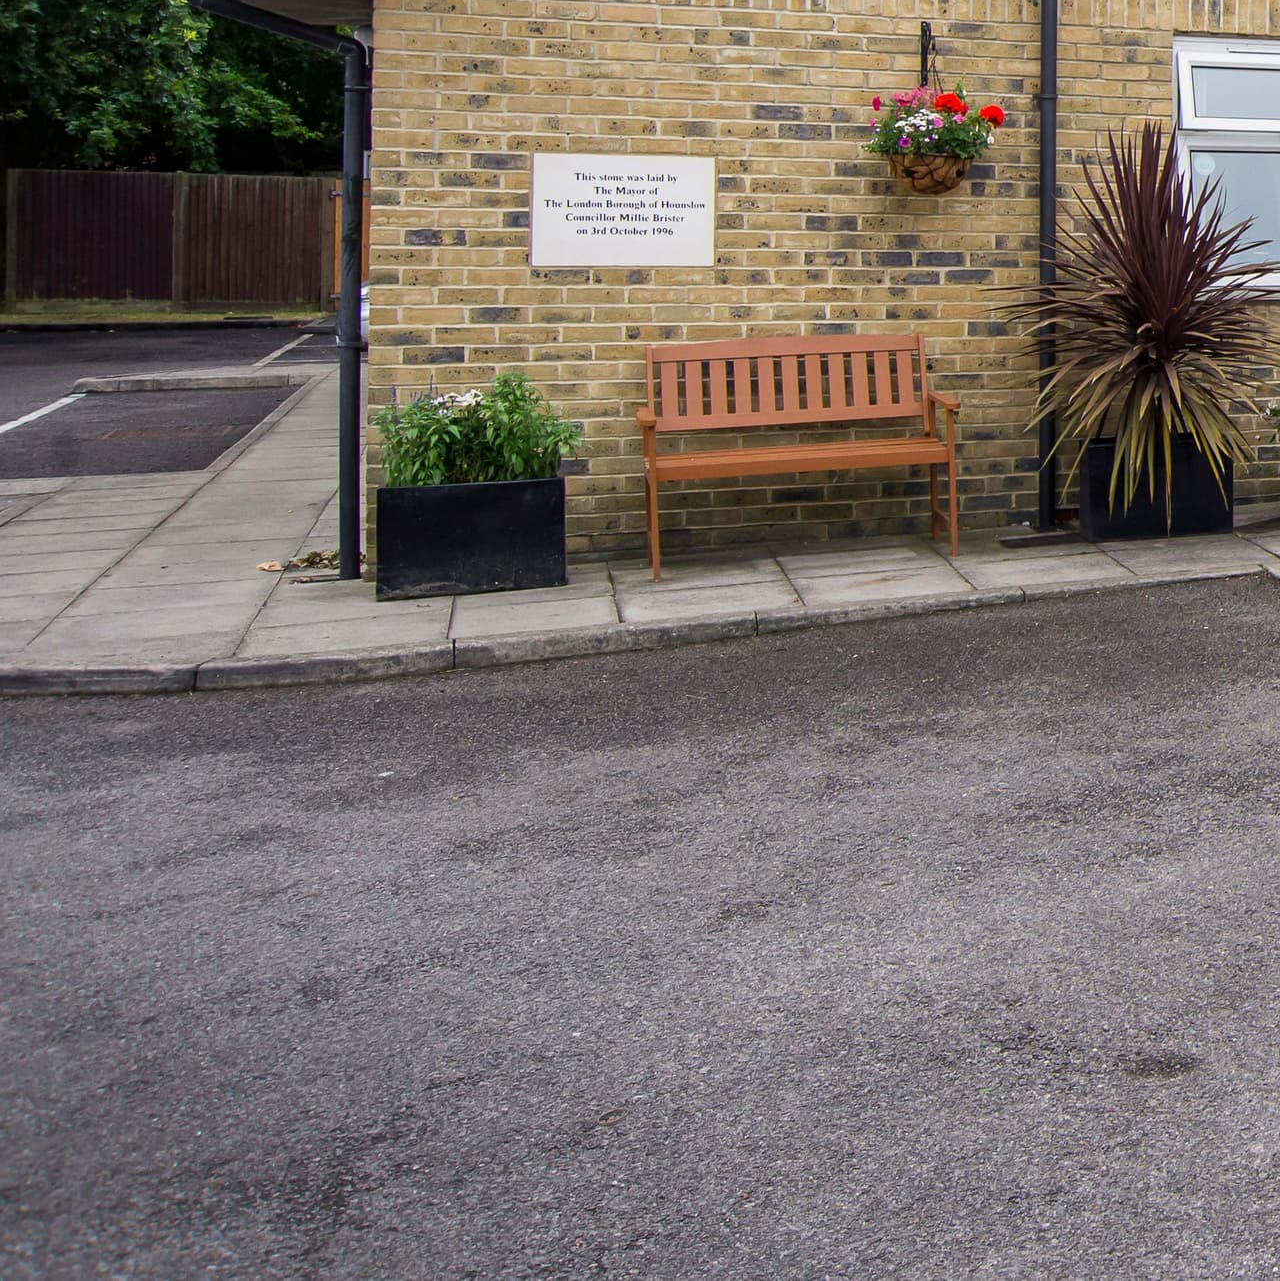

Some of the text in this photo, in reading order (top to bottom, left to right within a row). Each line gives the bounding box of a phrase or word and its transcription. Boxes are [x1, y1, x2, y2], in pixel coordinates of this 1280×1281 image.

[574, 172, 597, 181] This
[599, 174, 624, 182] stone
[647, 173, 665, 182] laid
[667, 174, 678, 184] by
[593, 186, 659, 197] The Mayor of
[544, 199, 706, 210] The London Borough of Hounslow
[565, 212, 685, 222] Councillor Millie Brister
[591, 226, 607, 235] 3rd
[609, 226, 648, 236] October
[652, 227, 674, 236] 1996
